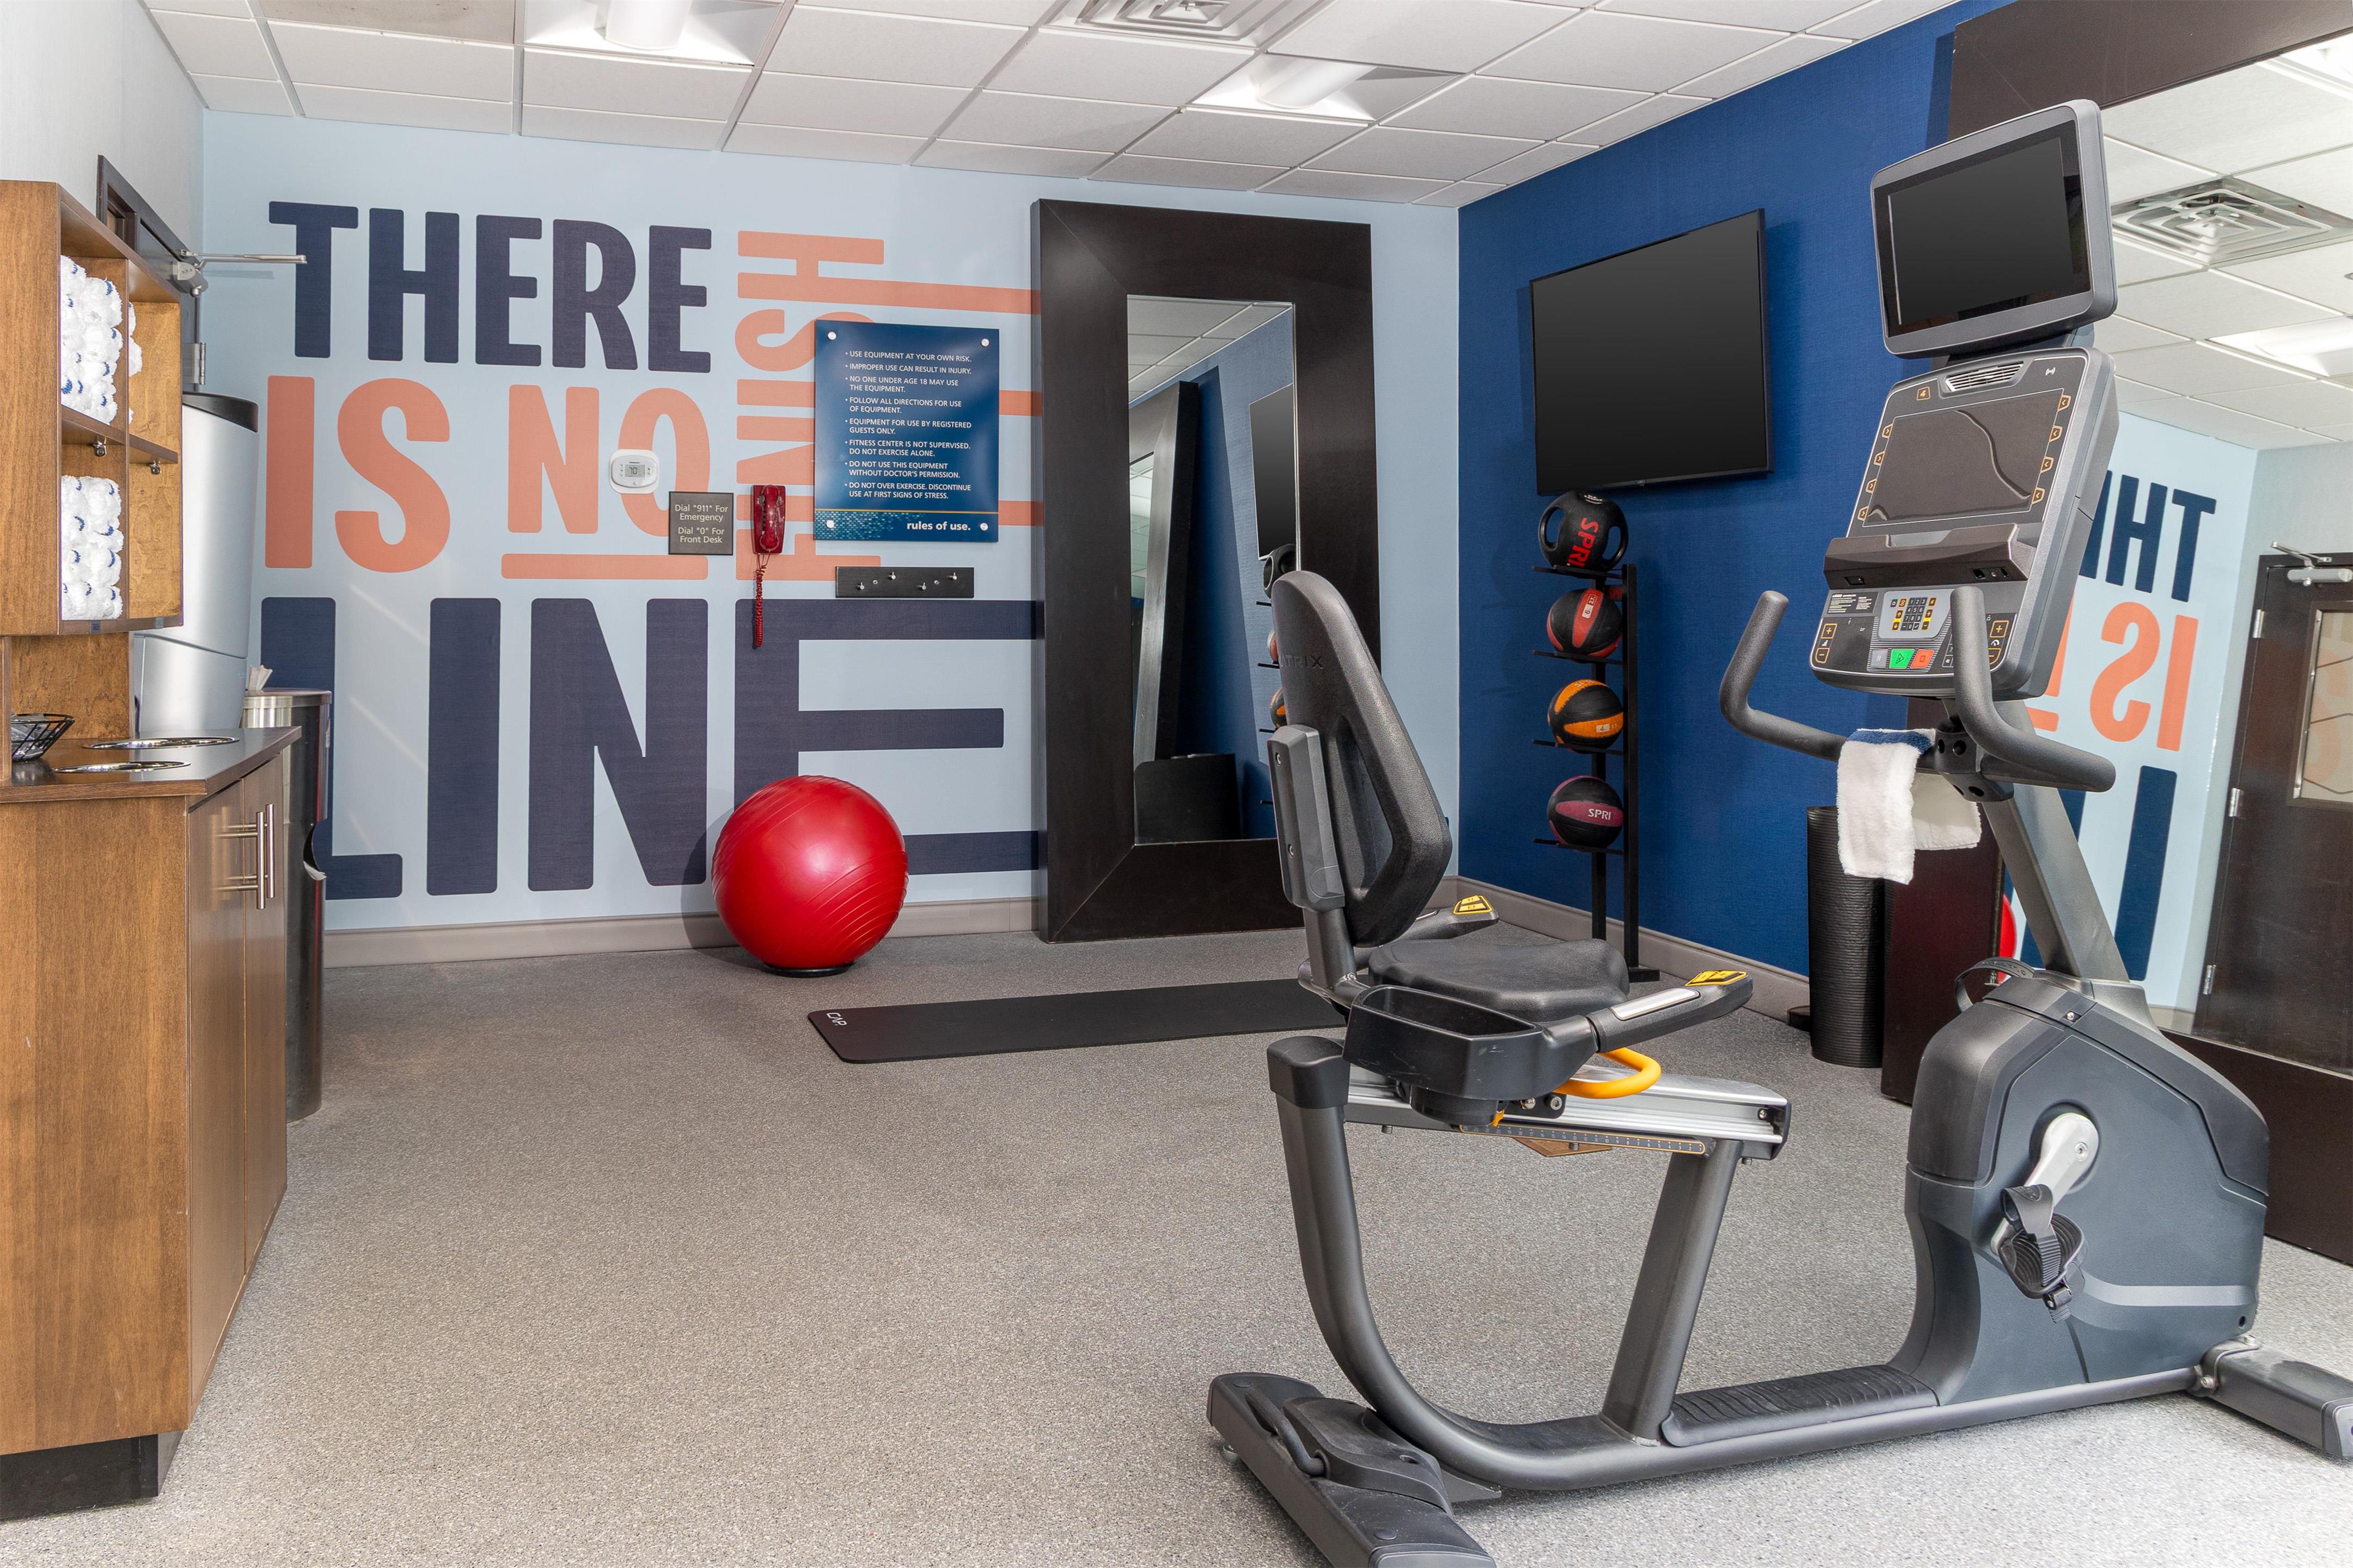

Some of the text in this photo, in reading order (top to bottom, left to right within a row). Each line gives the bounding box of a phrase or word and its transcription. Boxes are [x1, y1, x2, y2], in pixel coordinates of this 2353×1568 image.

[269, 201, 711, 373] THERE
[265, 375, 711, 573] IS NO
[628, 467, 638, 475] 70
[680, 513, 723, 523] Emergency
[907, 521, 933, 530] rules
[936, 521, 947, 531] of
[1567, 517, 1599, 567] SPRI
[1588, 808, 1611, 820] SPRI
